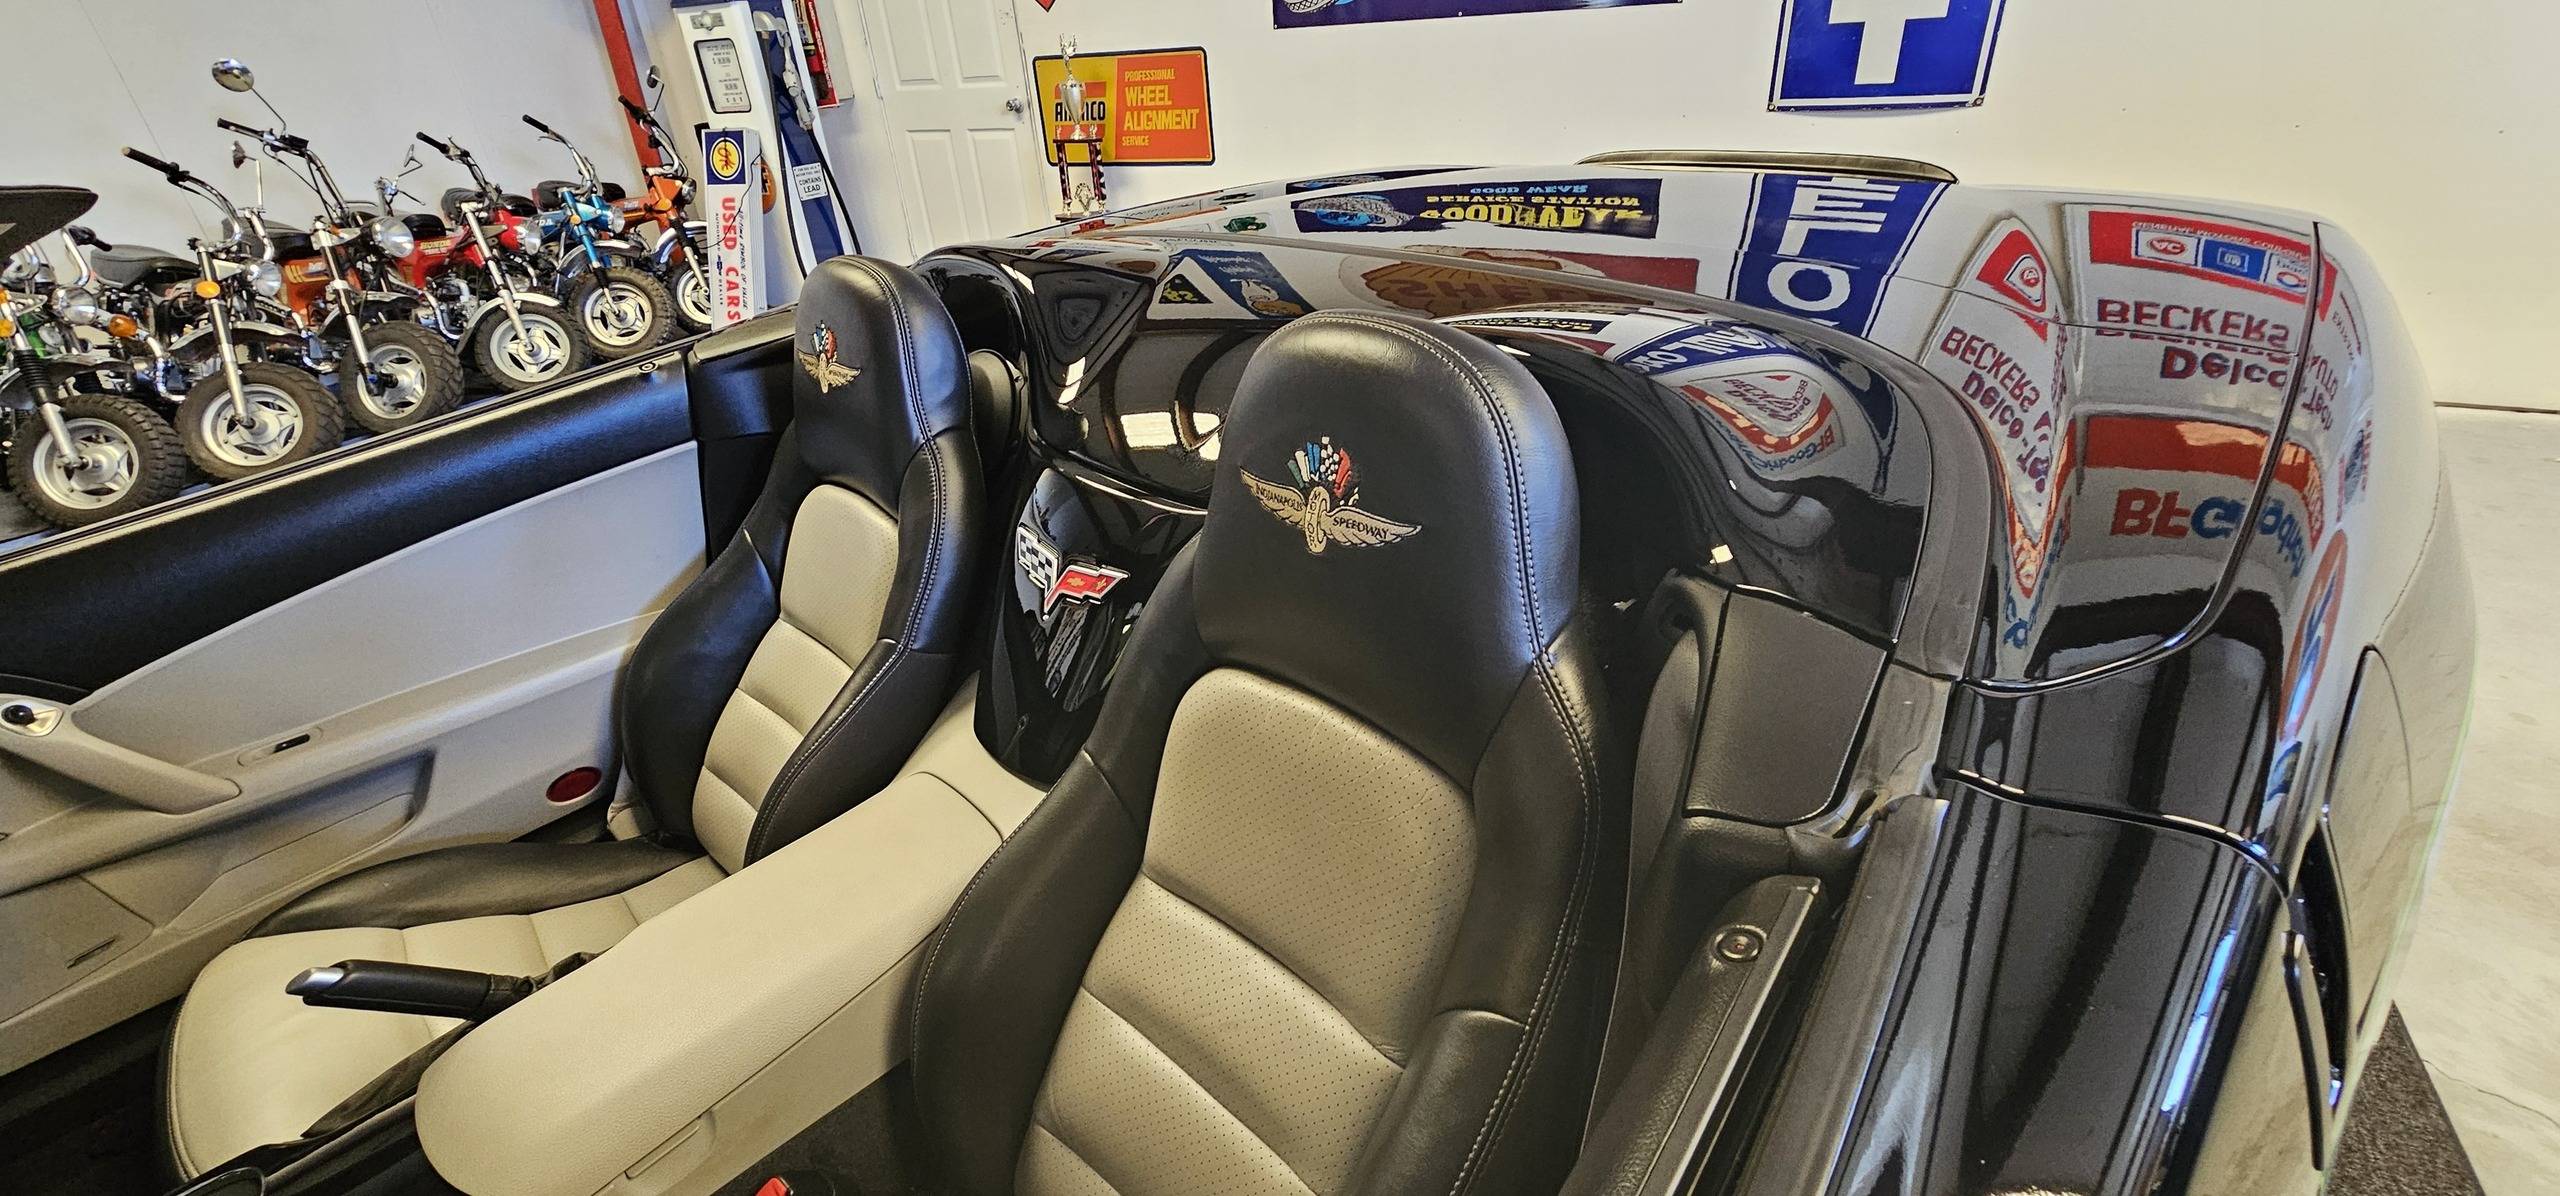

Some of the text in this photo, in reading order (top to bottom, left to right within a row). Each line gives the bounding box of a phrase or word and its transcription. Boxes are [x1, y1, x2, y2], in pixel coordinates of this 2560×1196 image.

[1124, 68, 1176, 82] PROFESSIONAL
[1125, 84, 1173, 107] WHEEL
[1123, 108, 1200, 131] ALIGNMENT
[1122, 135, 1150, 146] SERVICE
[803, 184, 821, 193] LEAD
[722, 197, 742, 321] USED CARS
[1308, 491, 1321, 548] MOTOR
[1332, 516, 1390, 540] SPEEDWAY
